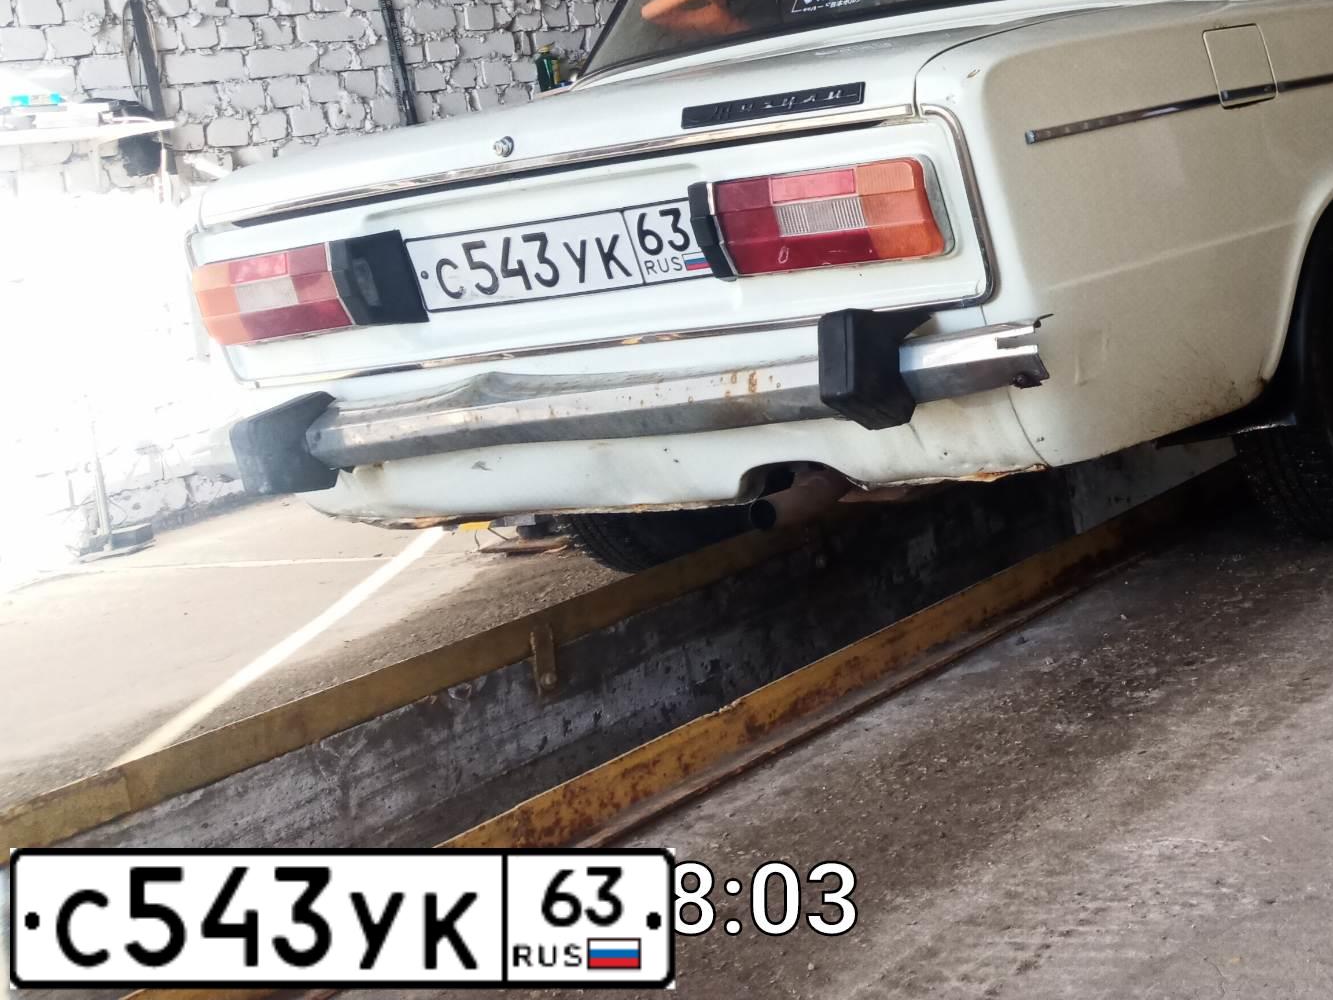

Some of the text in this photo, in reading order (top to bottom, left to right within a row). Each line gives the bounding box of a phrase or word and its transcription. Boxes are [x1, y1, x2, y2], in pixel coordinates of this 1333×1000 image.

[435, 207, 690, 300] С543УК 63
[644, 253, 683, 275] RUS
